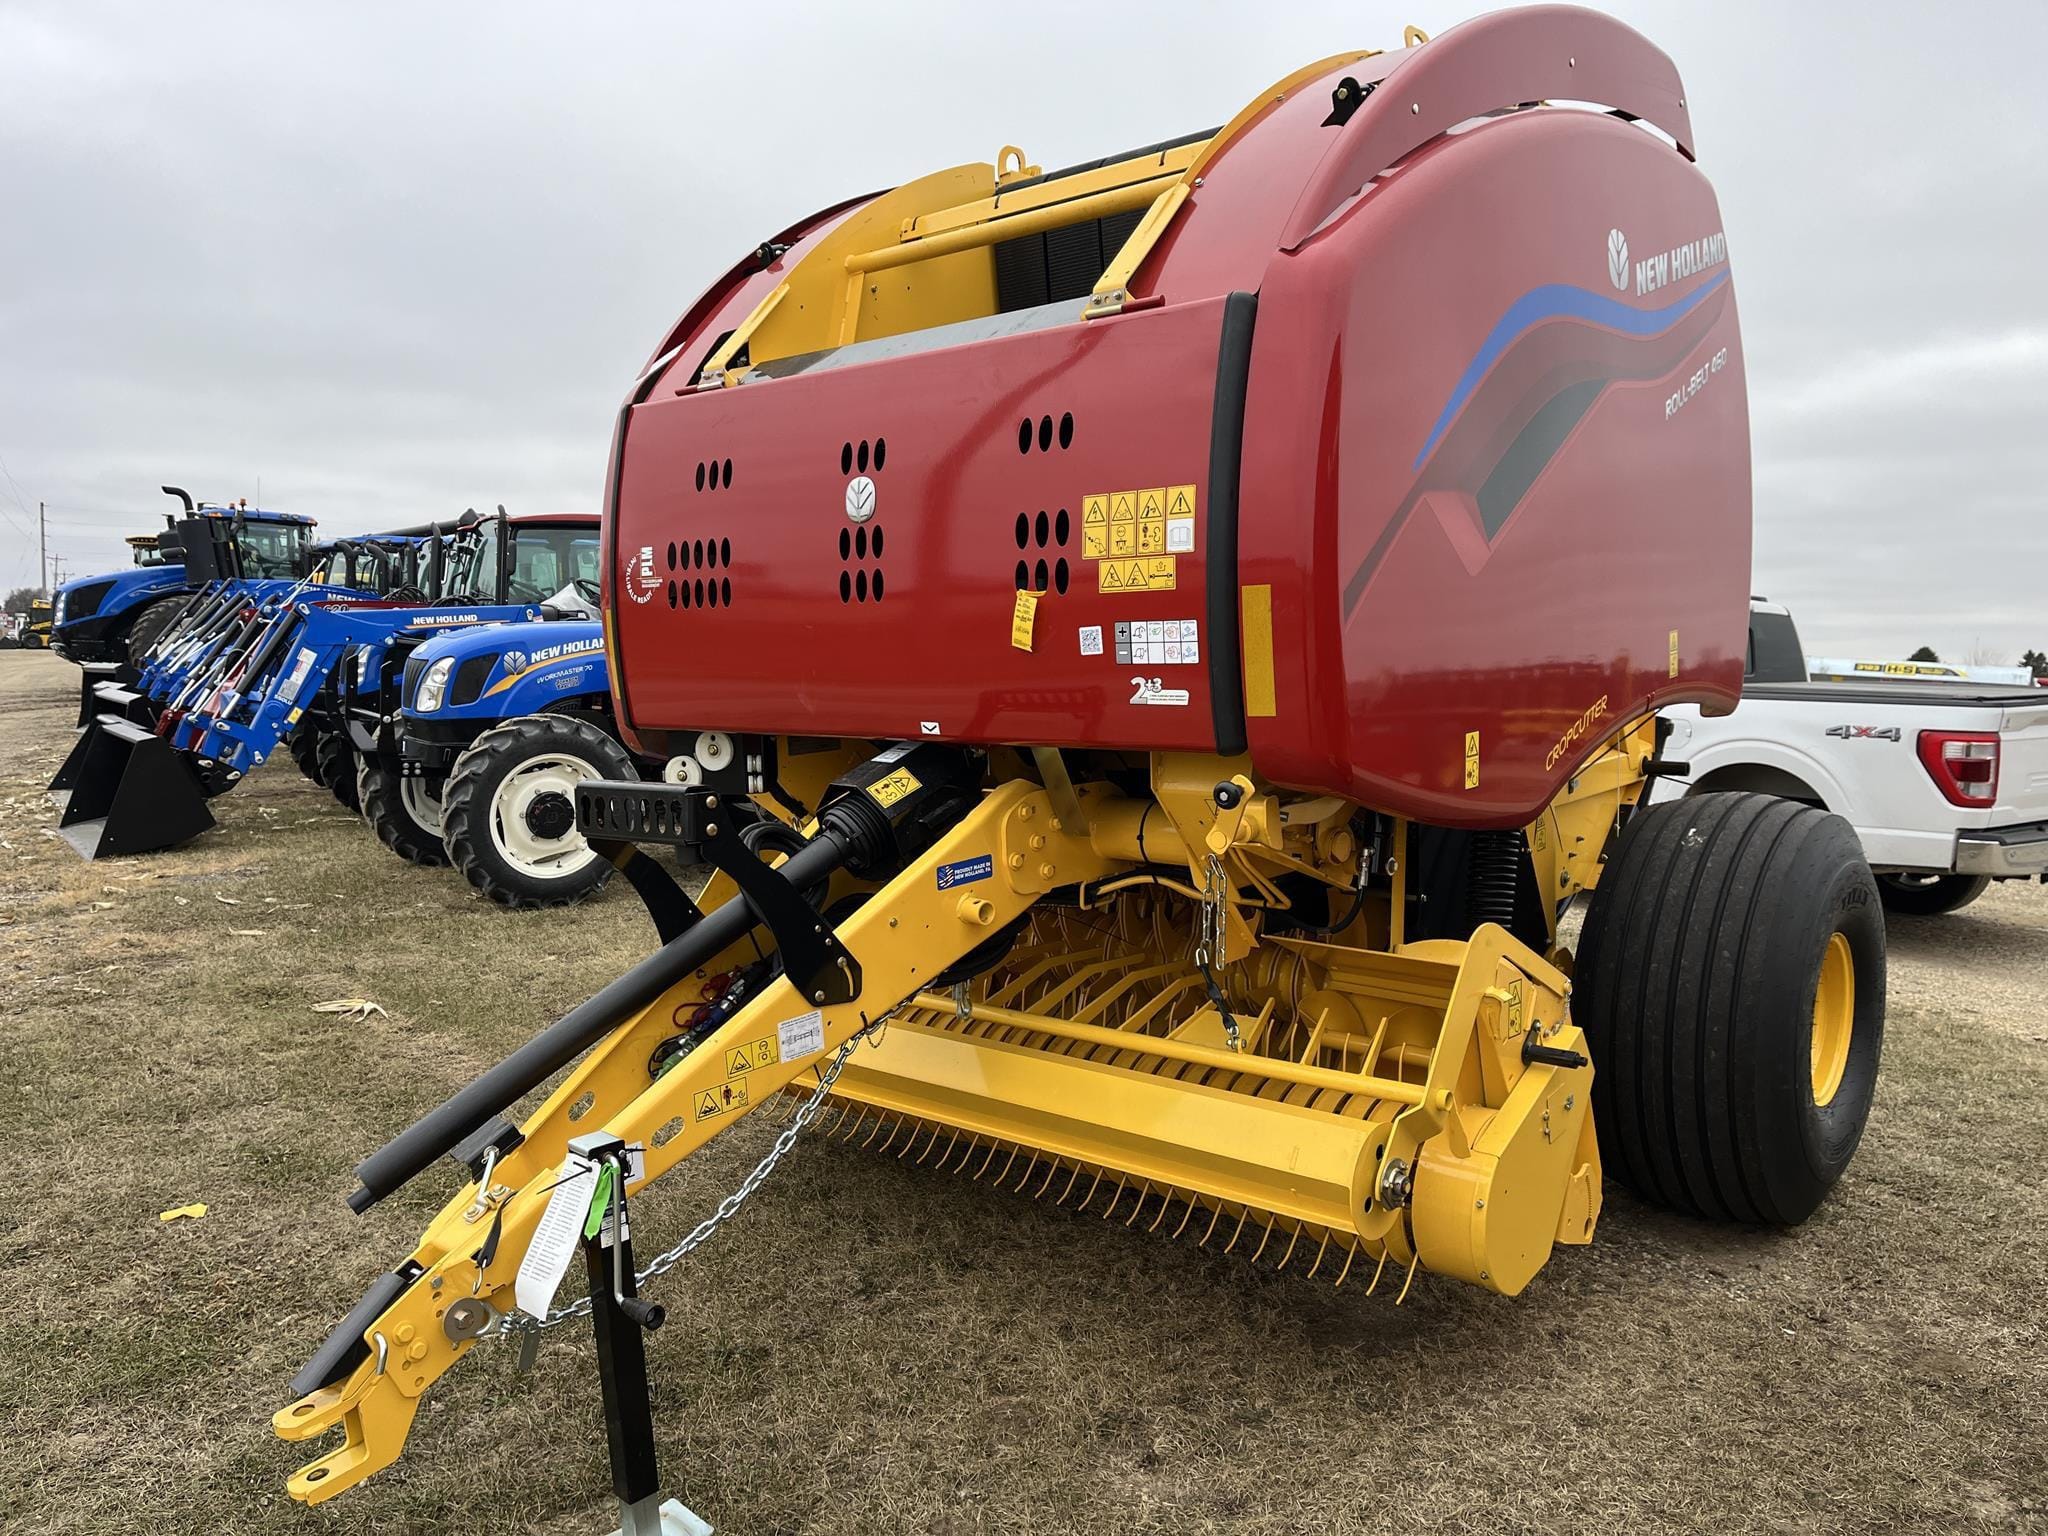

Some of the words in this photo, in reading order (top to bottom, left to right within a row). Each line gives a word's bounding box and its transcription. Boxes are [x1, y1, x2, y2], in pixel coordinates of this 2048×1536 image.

[1636, 253, 1668, 297] NEW
[1672, 232, 1726, 282] HOLLAND
[1665, 362, 1709, 420] ROLL-BELT
[641, 546, 653, 577] PLM
[412, 616, 434, 625] NEW
[435, 614, 478, 624] HOLLAND
[531, 645, 560, 663] NEW
[1545, 694, 1608, 771] CROPCUTTER
